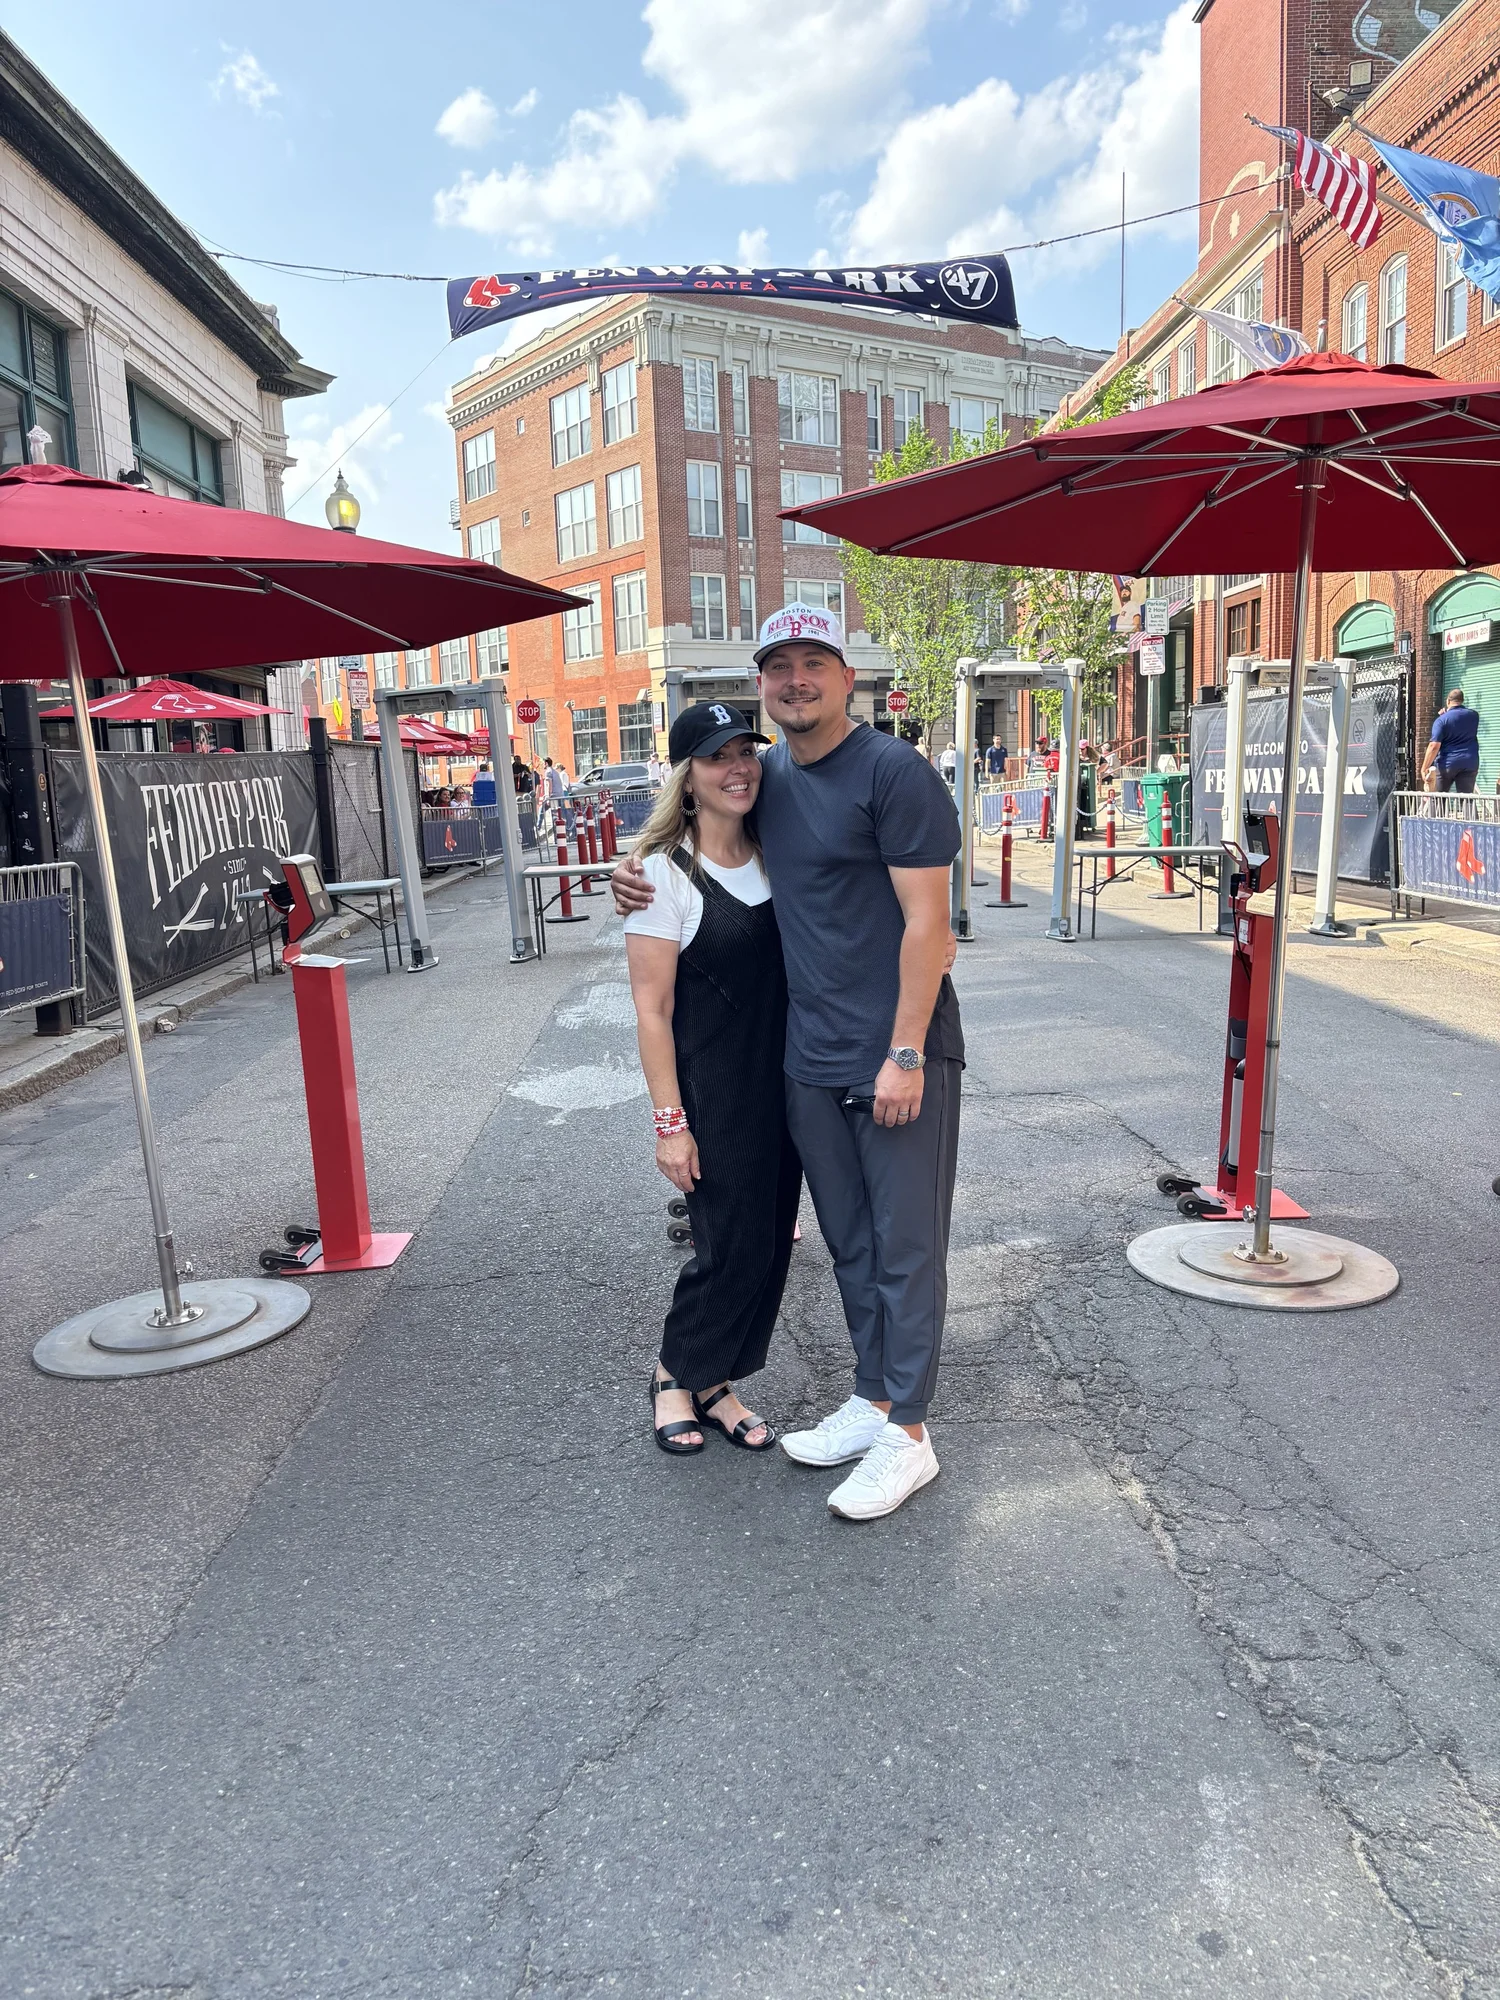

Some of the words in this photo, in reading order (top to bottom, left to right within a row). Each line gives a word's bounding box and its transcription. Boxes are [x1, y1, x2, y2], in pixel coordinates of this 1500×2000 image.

[693, 281, 753, 291] GATE
[763, 282, 778, 292] A
[768, 615, 793, 636] RED
[799, 613, 830, 633] SOX
[788, 621, 802, 637] B
[888, 697, 907, 707] STOP
[518, 706, 540, 717] STOP
[708, 704, 732, 726] B
[1245, 741, 1284, 757] WELCOM
[1204, 767, 1285, 794] FEWAY
[1295, 765, 1368, 795] PAK
